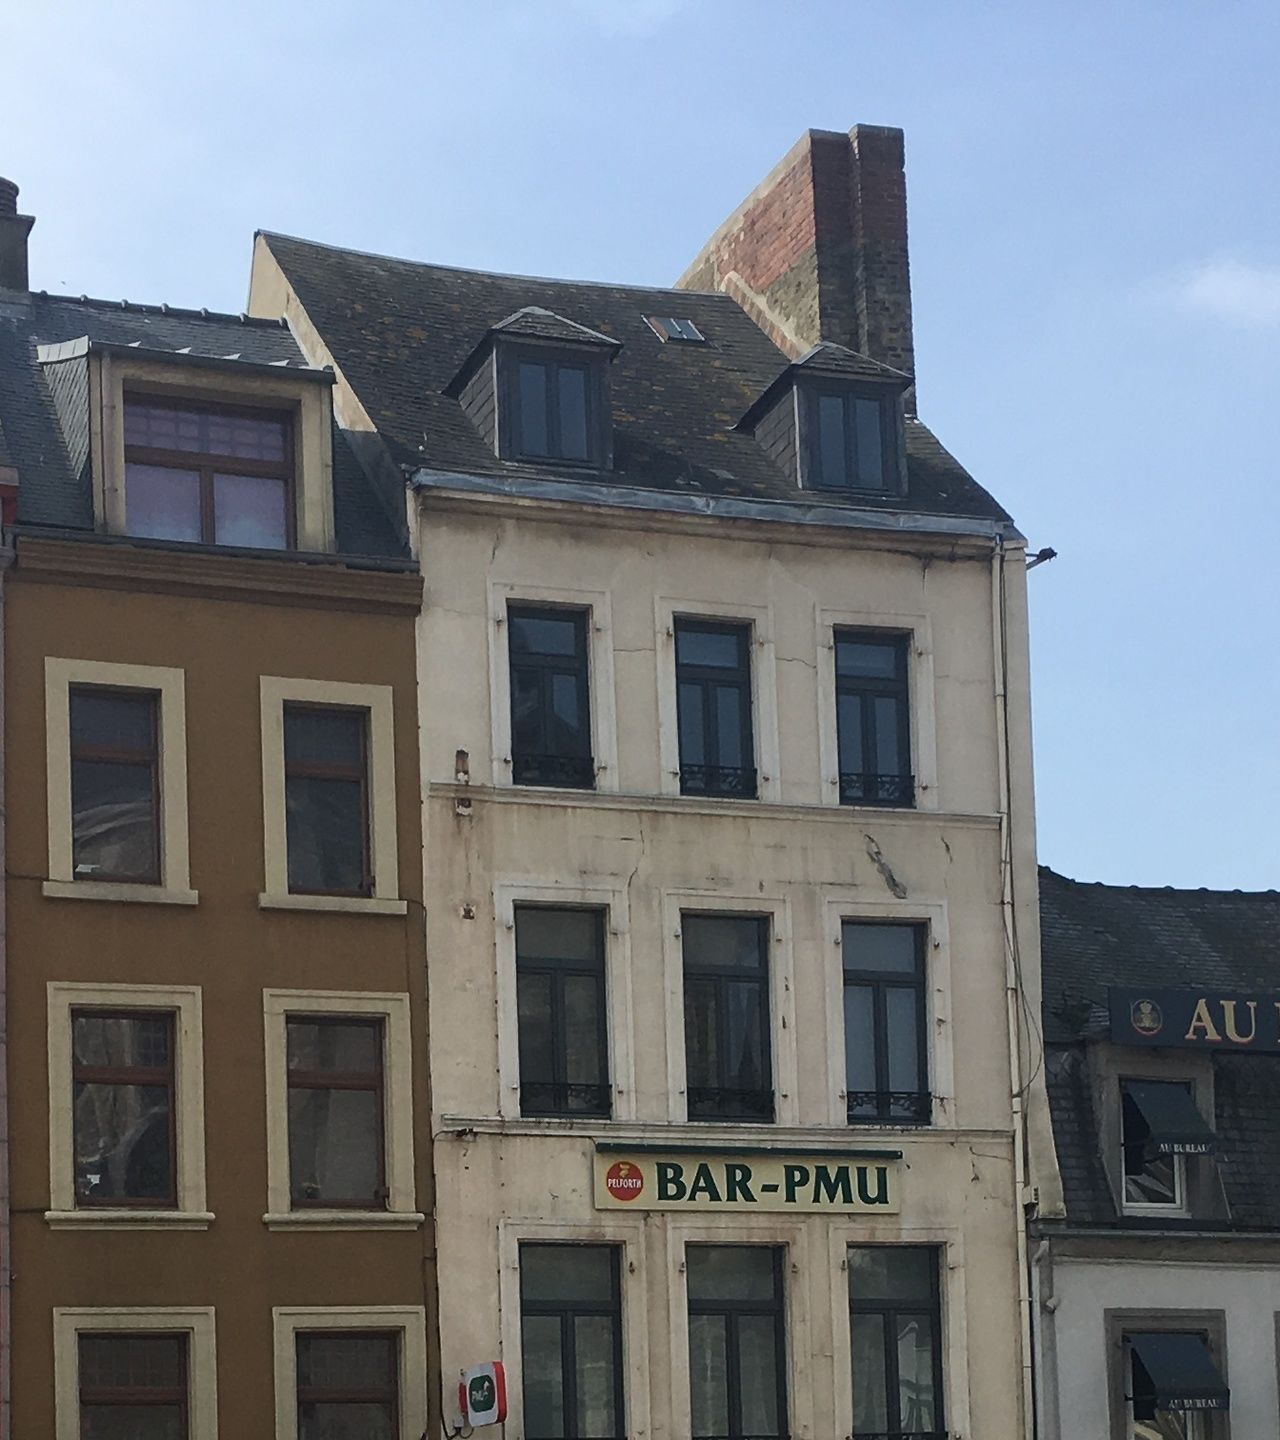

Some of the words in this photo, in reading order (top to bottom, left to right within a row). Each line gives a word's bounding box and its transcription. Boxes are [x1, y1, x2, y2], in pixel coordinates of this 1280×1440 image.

[1185, 998, 1258, 1045] AU
[607, 1178, 642, 1189] PELFORTH
[655, 1161, 890, 1206] BAR-PMU
